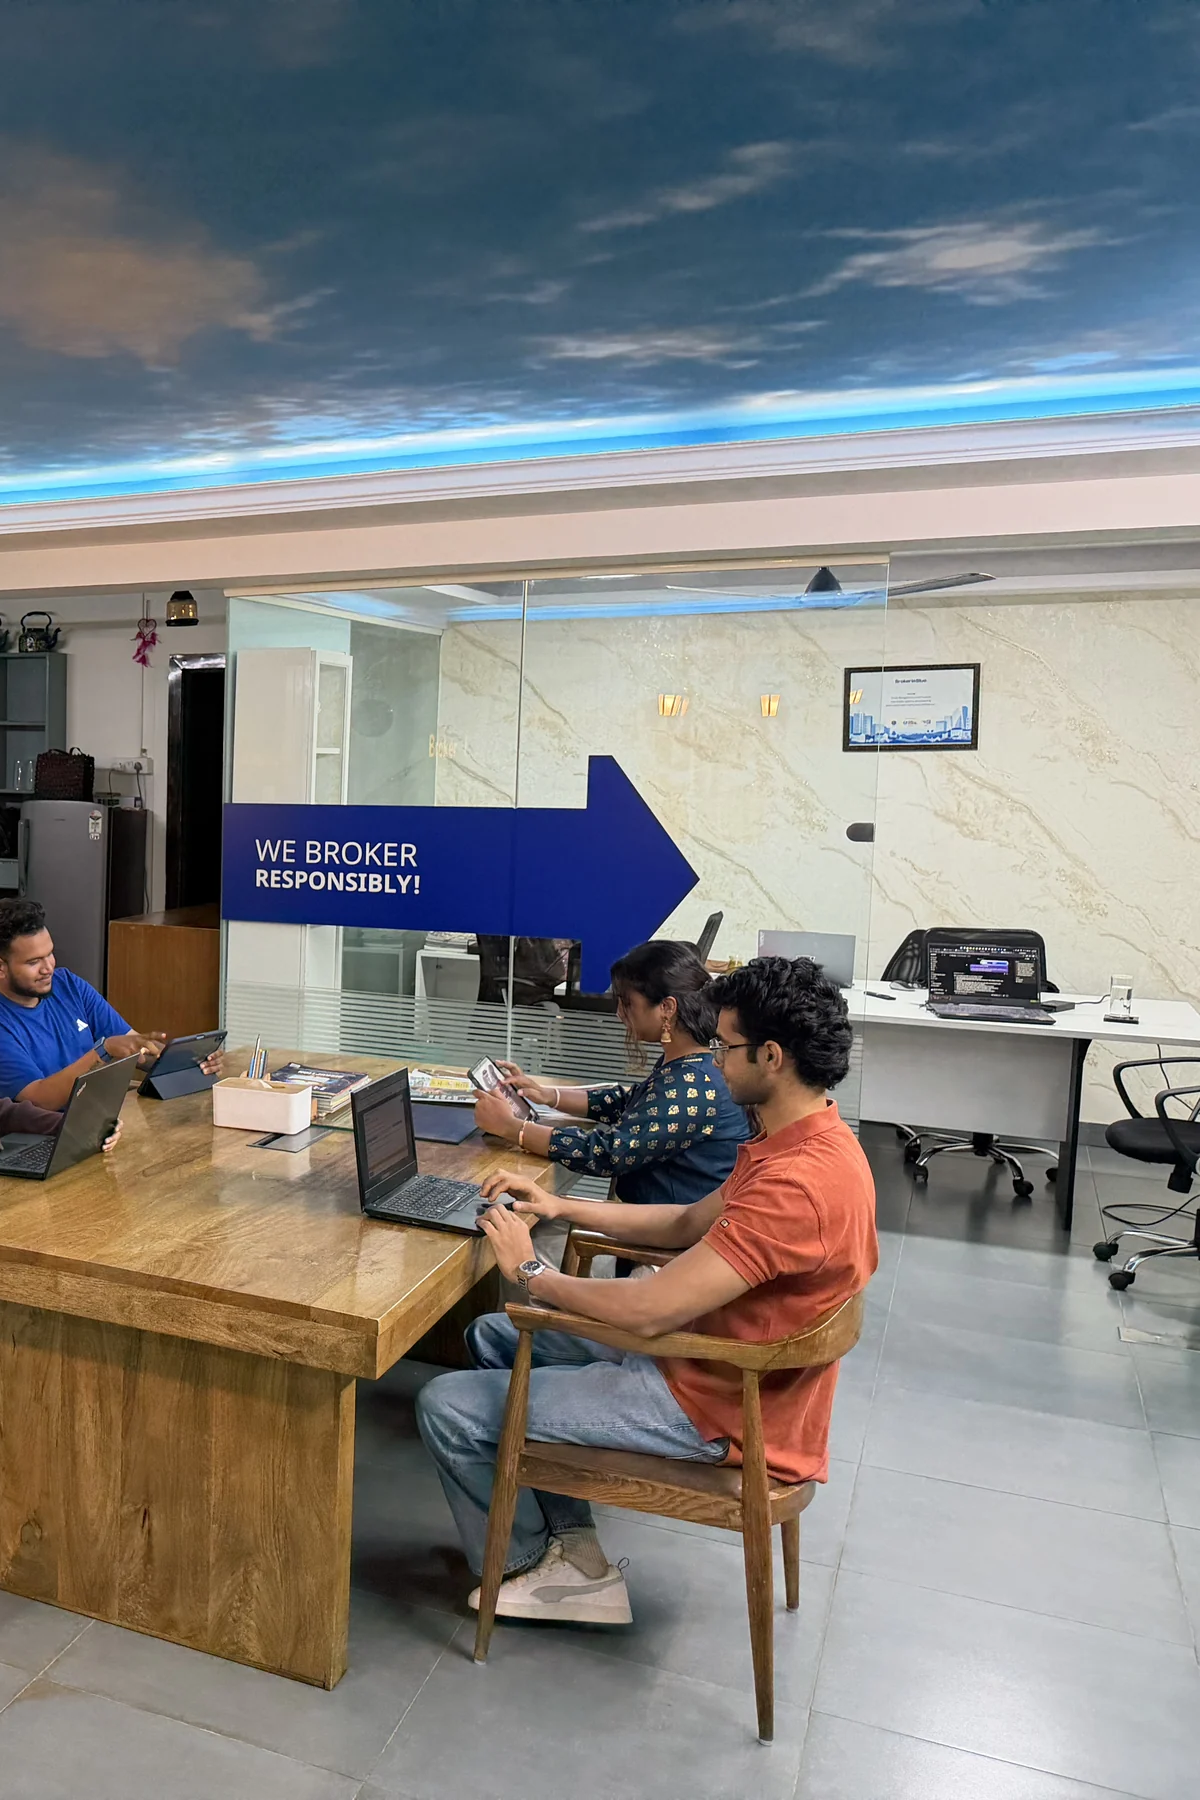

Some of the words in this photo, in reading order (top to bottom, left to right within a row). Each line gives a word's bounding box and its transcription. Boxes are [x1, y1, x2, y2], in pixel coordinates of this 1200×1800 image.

[255, 839, 297, 863] WE
[305, 840, 418, 868] BROKER
[255, 869, 421, 895] RESPONSIBLY!
